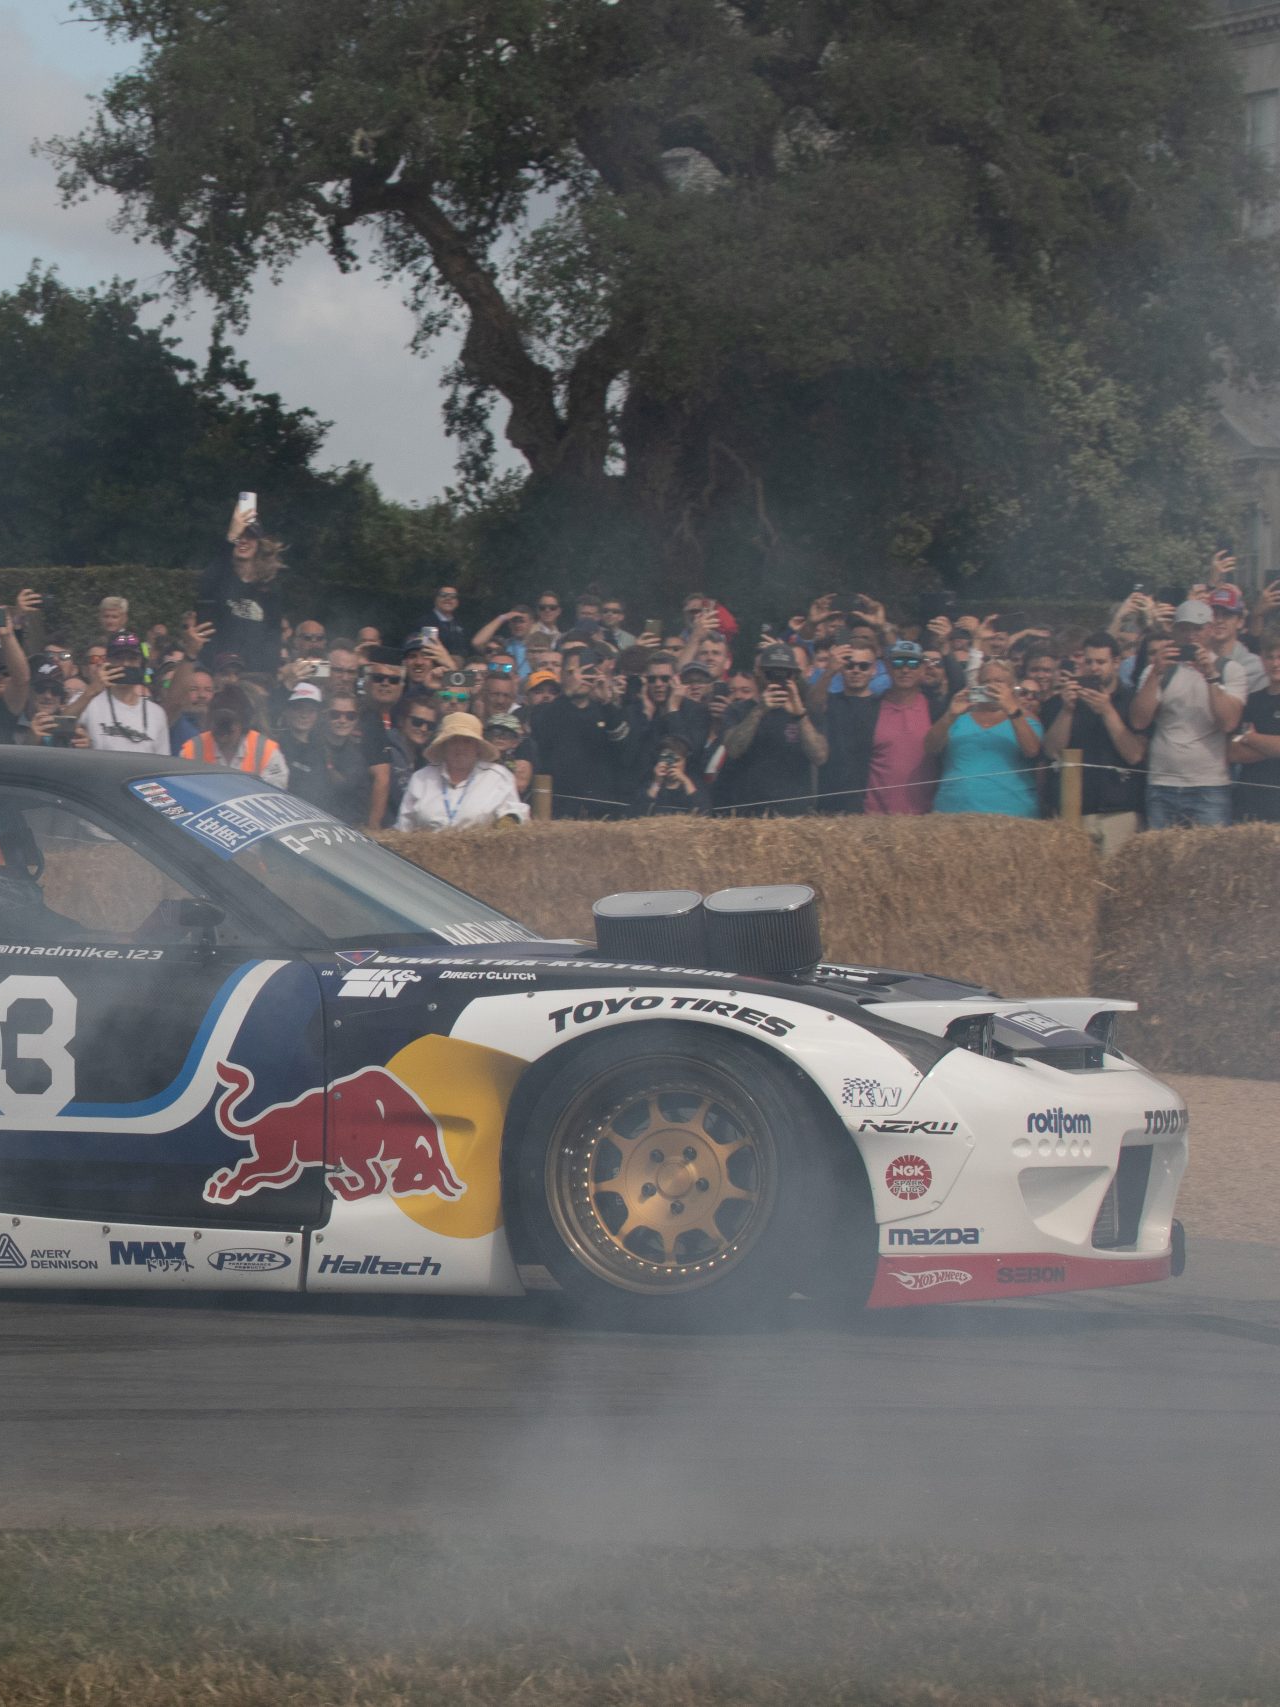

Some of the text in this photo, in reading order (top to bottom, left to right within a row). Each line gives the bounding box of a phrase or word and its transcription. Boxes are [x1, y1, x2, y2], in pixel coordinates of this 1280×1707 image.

[438, 970, 537, 981] DIRECT CLUTCH
[548, 995, 796, 1037] TOYO TIRES
[851, 1086, 902, 1108] KW
[1027, 1107, 1092, 1138] rotiform
[892, 1164, 926, 1176] NGK
[888, 1228, 980, 1246] mazda
[31, 1249, 71, 1259] AVERY
[109, 1241, 186, 1265] MAX
[217, 1252, 284, 1271] PWR
[31, 1260, 98, 1270] DENNISON
[146, 1258, 195, 1272] ドリフト
[318, 1255, 442, 1276] Haltech
